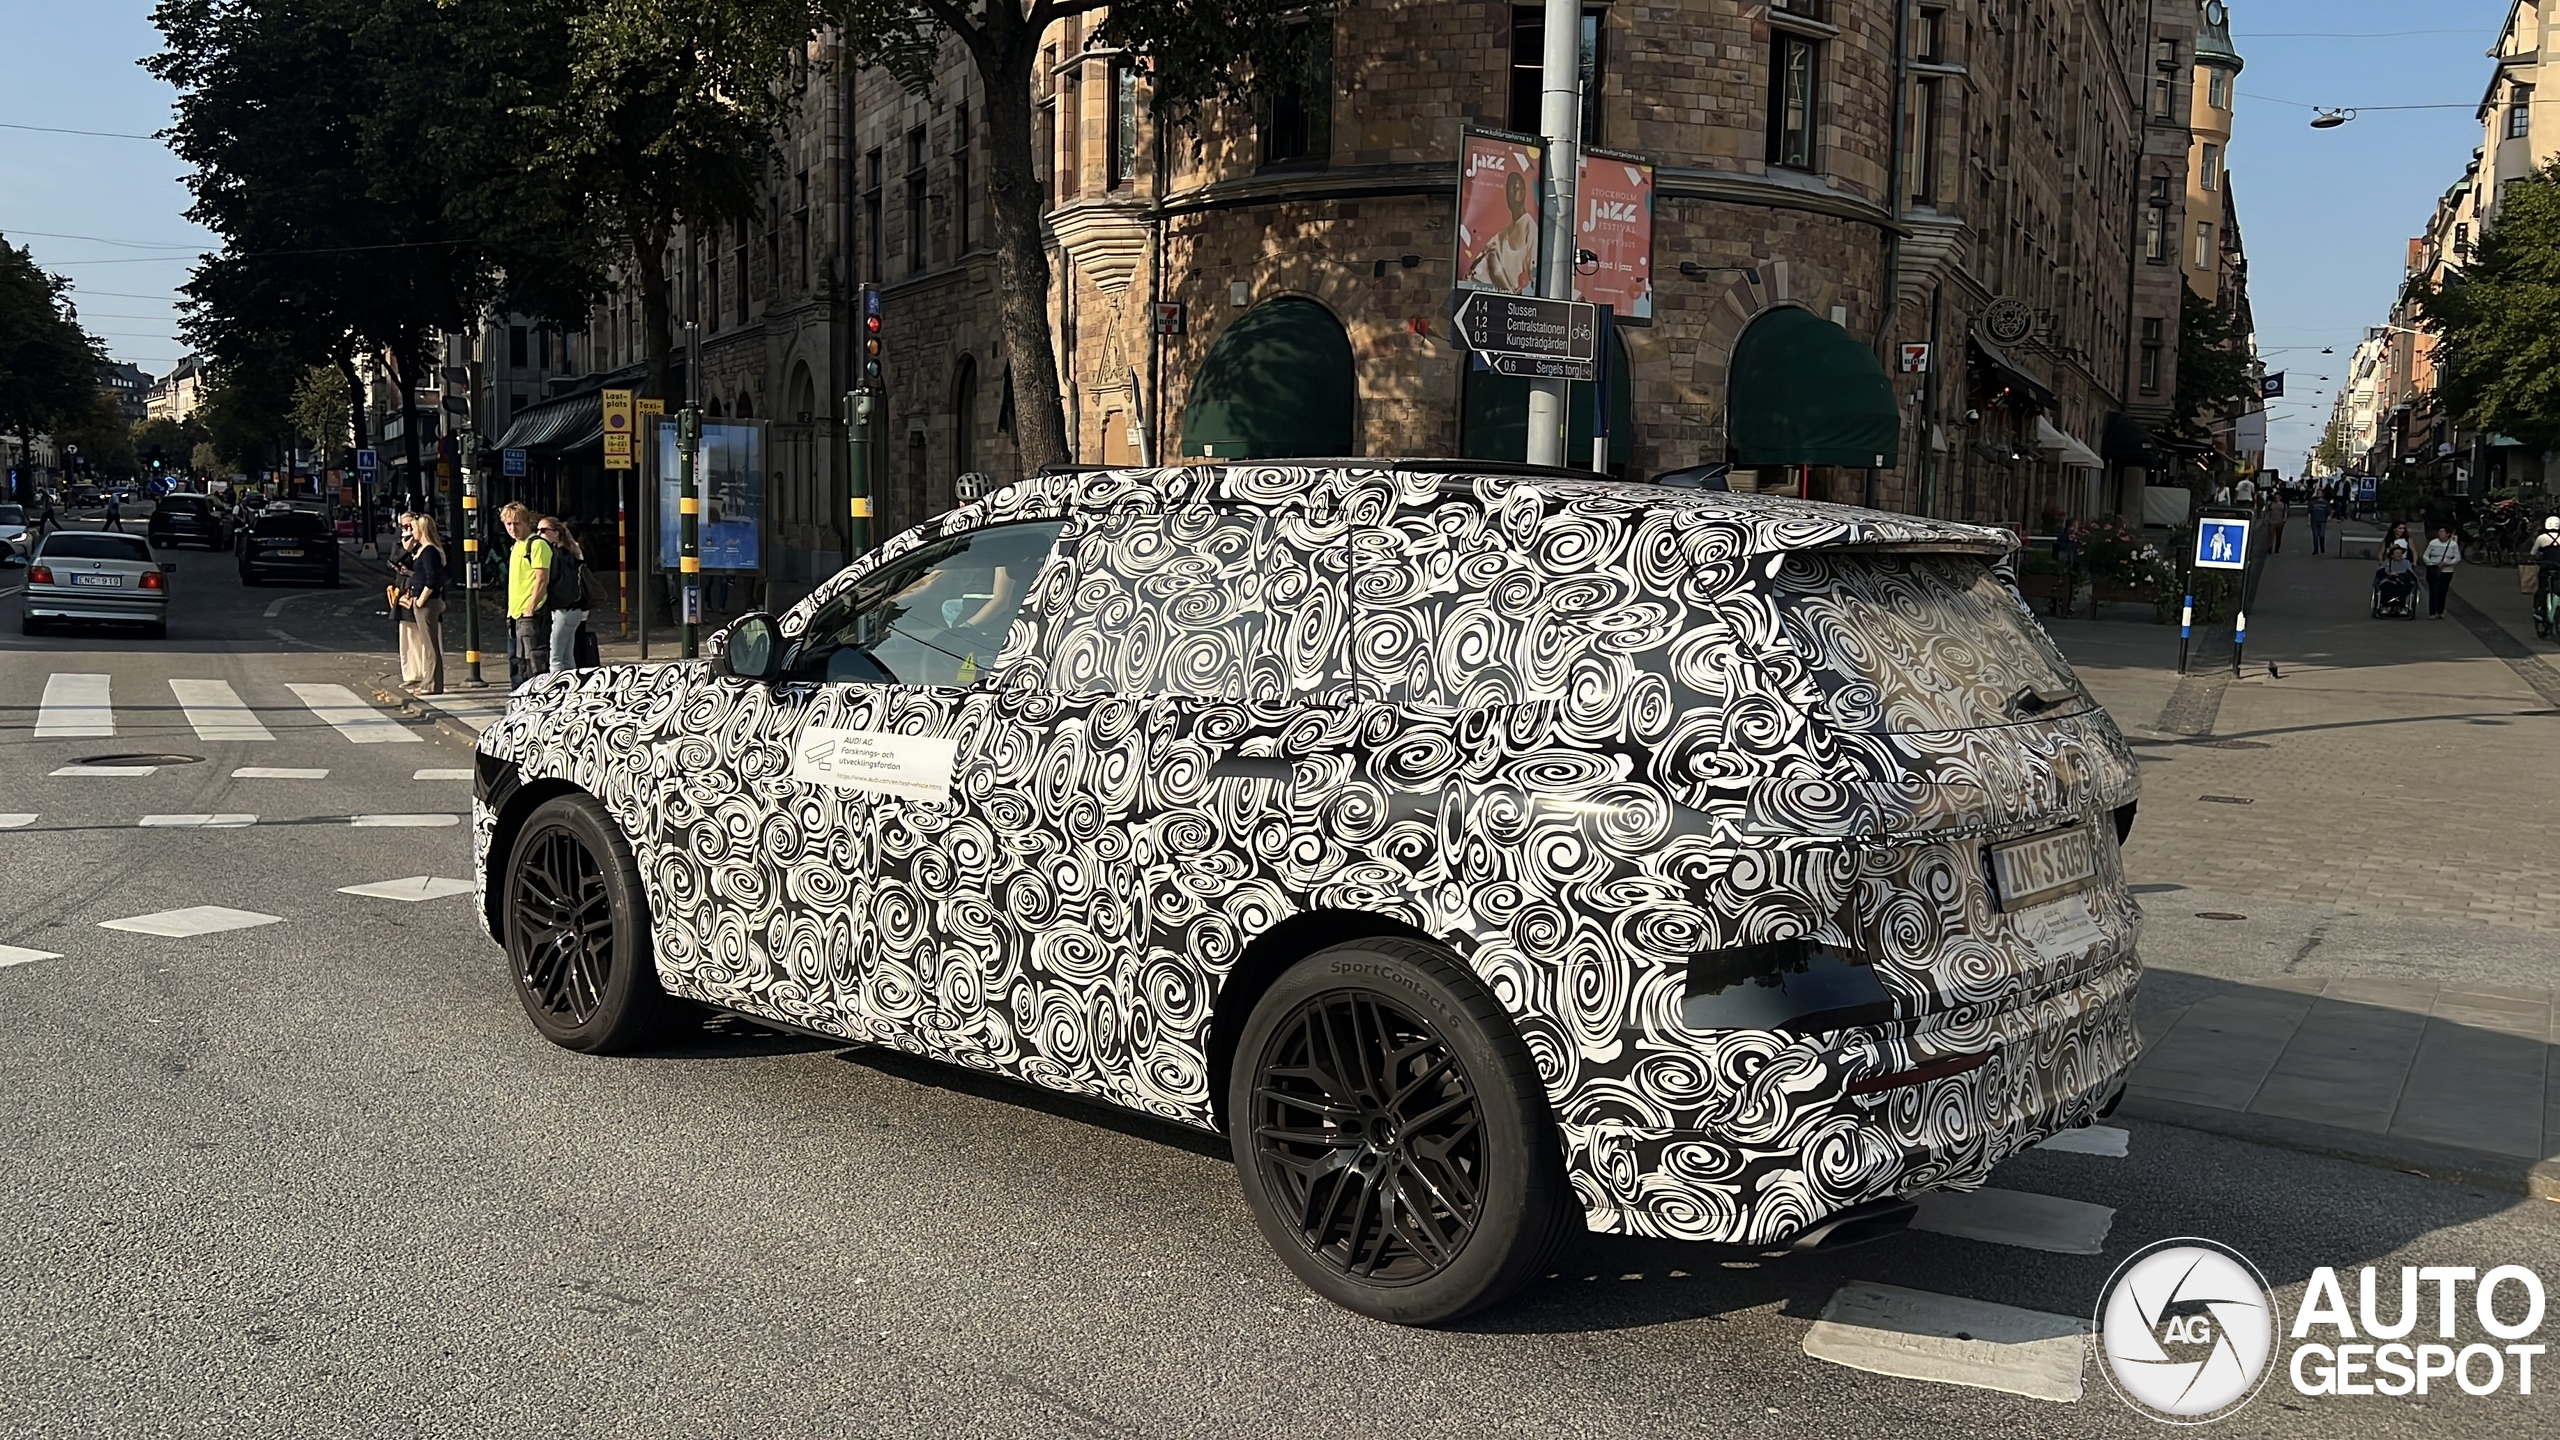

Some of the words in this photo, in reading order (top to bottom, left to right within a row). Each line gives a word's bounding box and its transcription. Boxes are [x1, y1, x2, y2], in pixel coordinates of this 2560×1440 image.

[1590, 188, 1637, 201] STOCKHOLM
[1598, 221, 1636, 234] FESTIVAL
[1475, 300, 1488, 314] 1,4
[1507, 302, 1537, 317] Slussen
[1160, 306, 1178, 333] 7
[1474, 316, 1488, 329] 1,2
[1506, 317, 1566, 335] Centralstationen
[1474, 330, 1488, 344] 0,3
[1506, 333, 1568, 351] Kungsträdgården
[1905, 347, 1926, 373] 7
[1504, 359, 1517, 373] 0,6
[1536, 361, 1563, 377] Sergels
[1565, 365, 1580, 378] torg
[605, 392, 628, 400] Last-
[606, 401, 628, 409] plats
[639, 401, 662, 409] Taxi-
[79, 576, 96, 584] ENC
[843, 736, 862, 745] AUDI
[862, 738, 874, 746] AG
[841, 746, 880, 758] Forsknings-
[881, 751, 895, 759] och
[839, 758, 901, 770] utvecklingsfordon
[1330, 961, 1447, 1015] SportContact
[1448, 1014, 1462, 1029] 6
